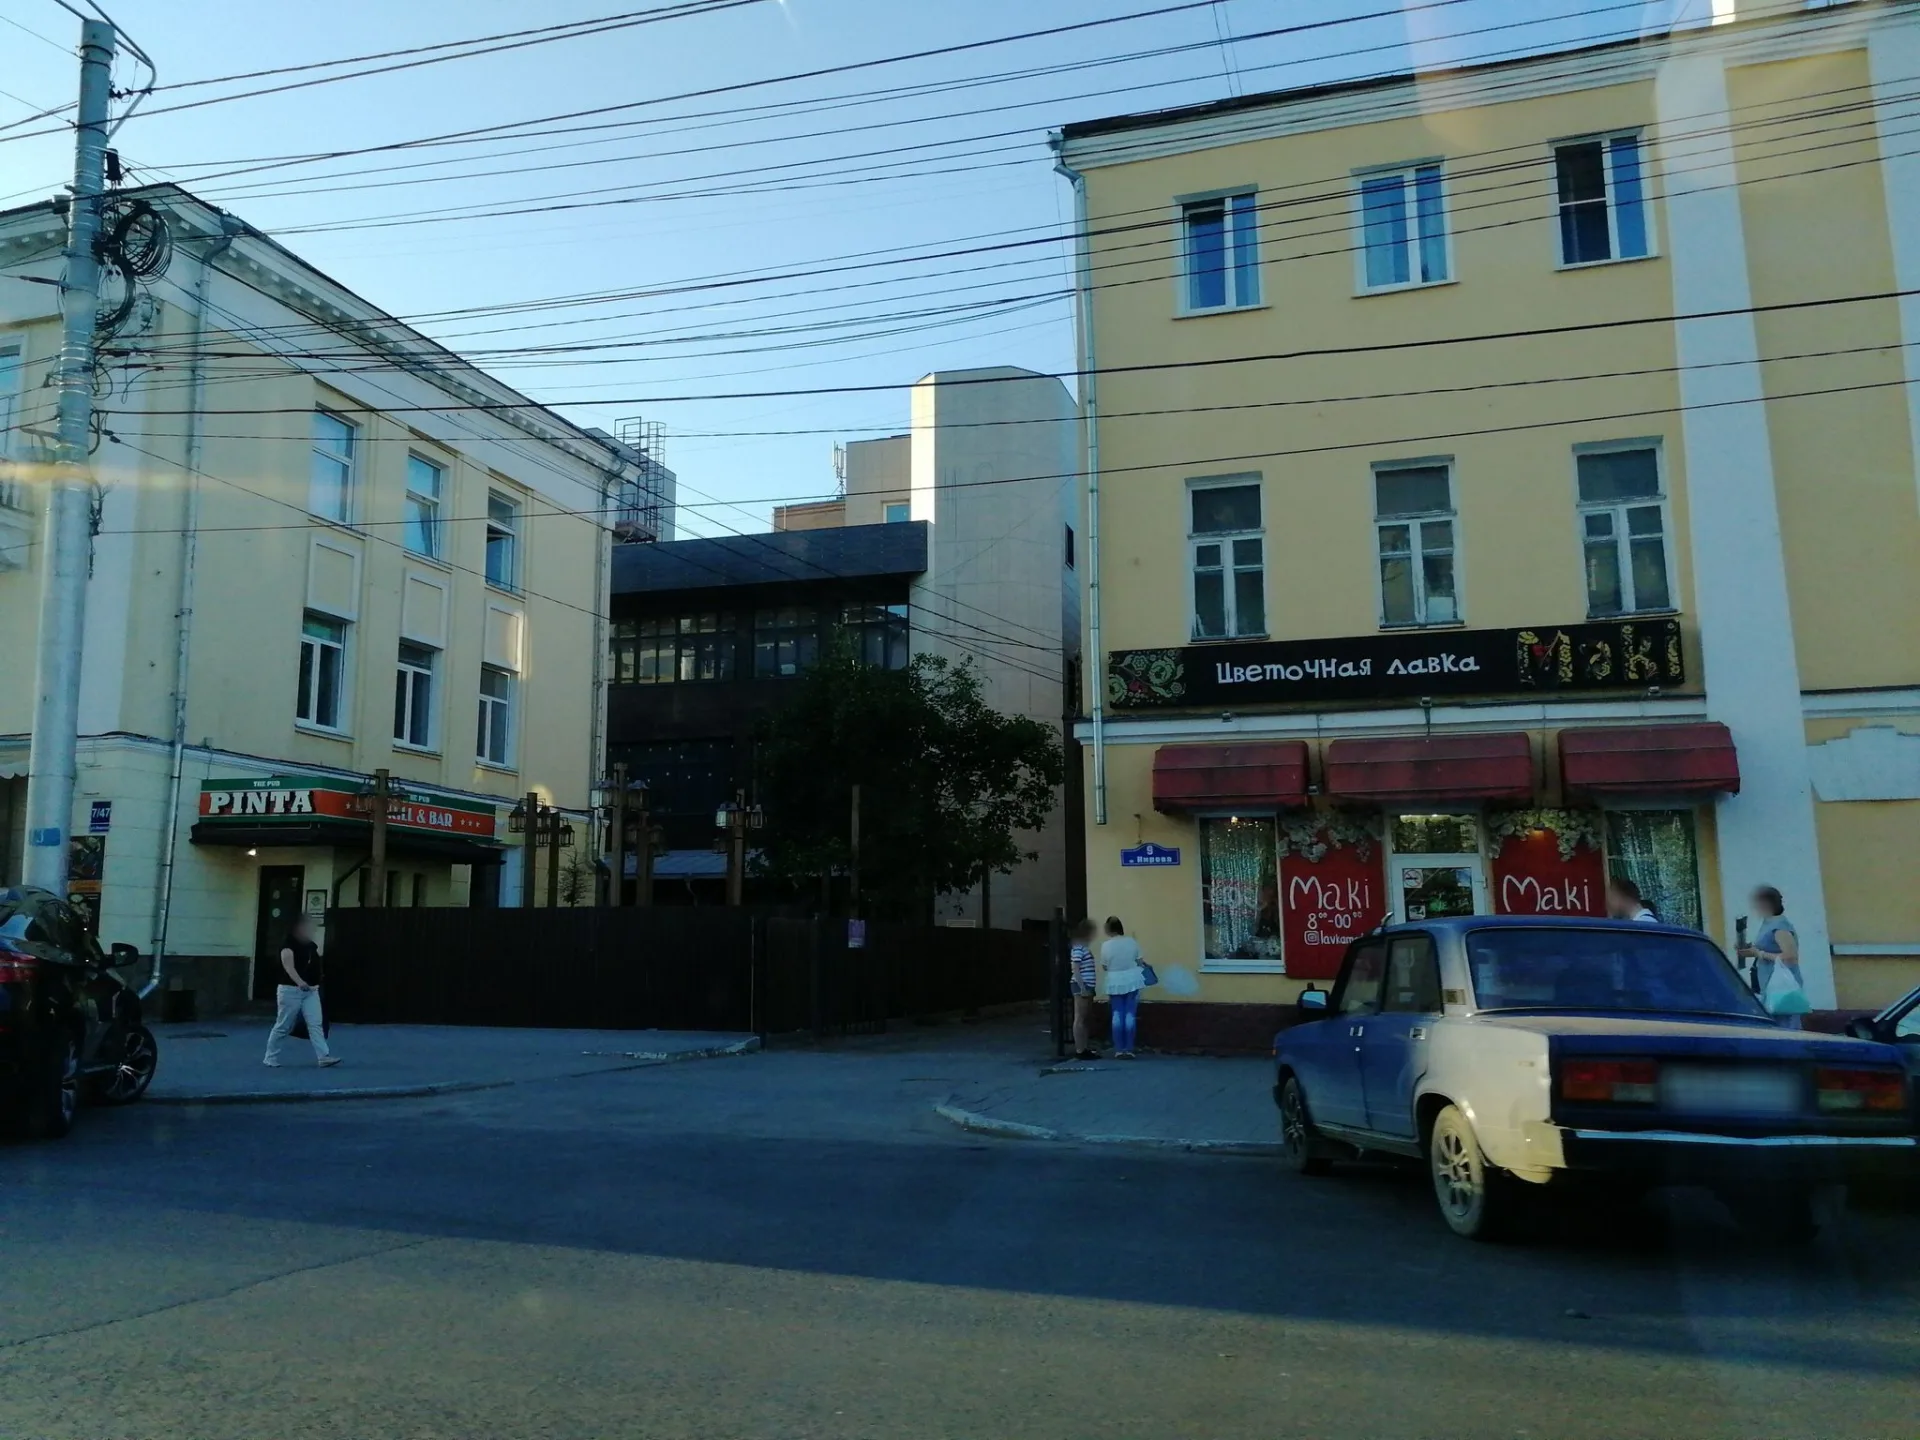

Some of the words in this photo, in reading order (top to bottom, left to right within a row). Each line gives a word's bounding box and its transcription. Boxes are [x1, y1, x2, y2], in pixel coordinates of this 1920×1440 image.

[1216, 658, 1372, 684] Цветочная
[1386, 653, 1480, 676] лавка
[91, 808, 110, 818] 7/47
[208, 790, 313, 815] PINTA
[429, 810, 453, 828] BAR
[1146, 845, 1154, 856] 9
[1289, 875, 1371, 911] Maki
[1502, 874, 1590, 912] Maki
[1320, 929, 1364, 945] lavkam
